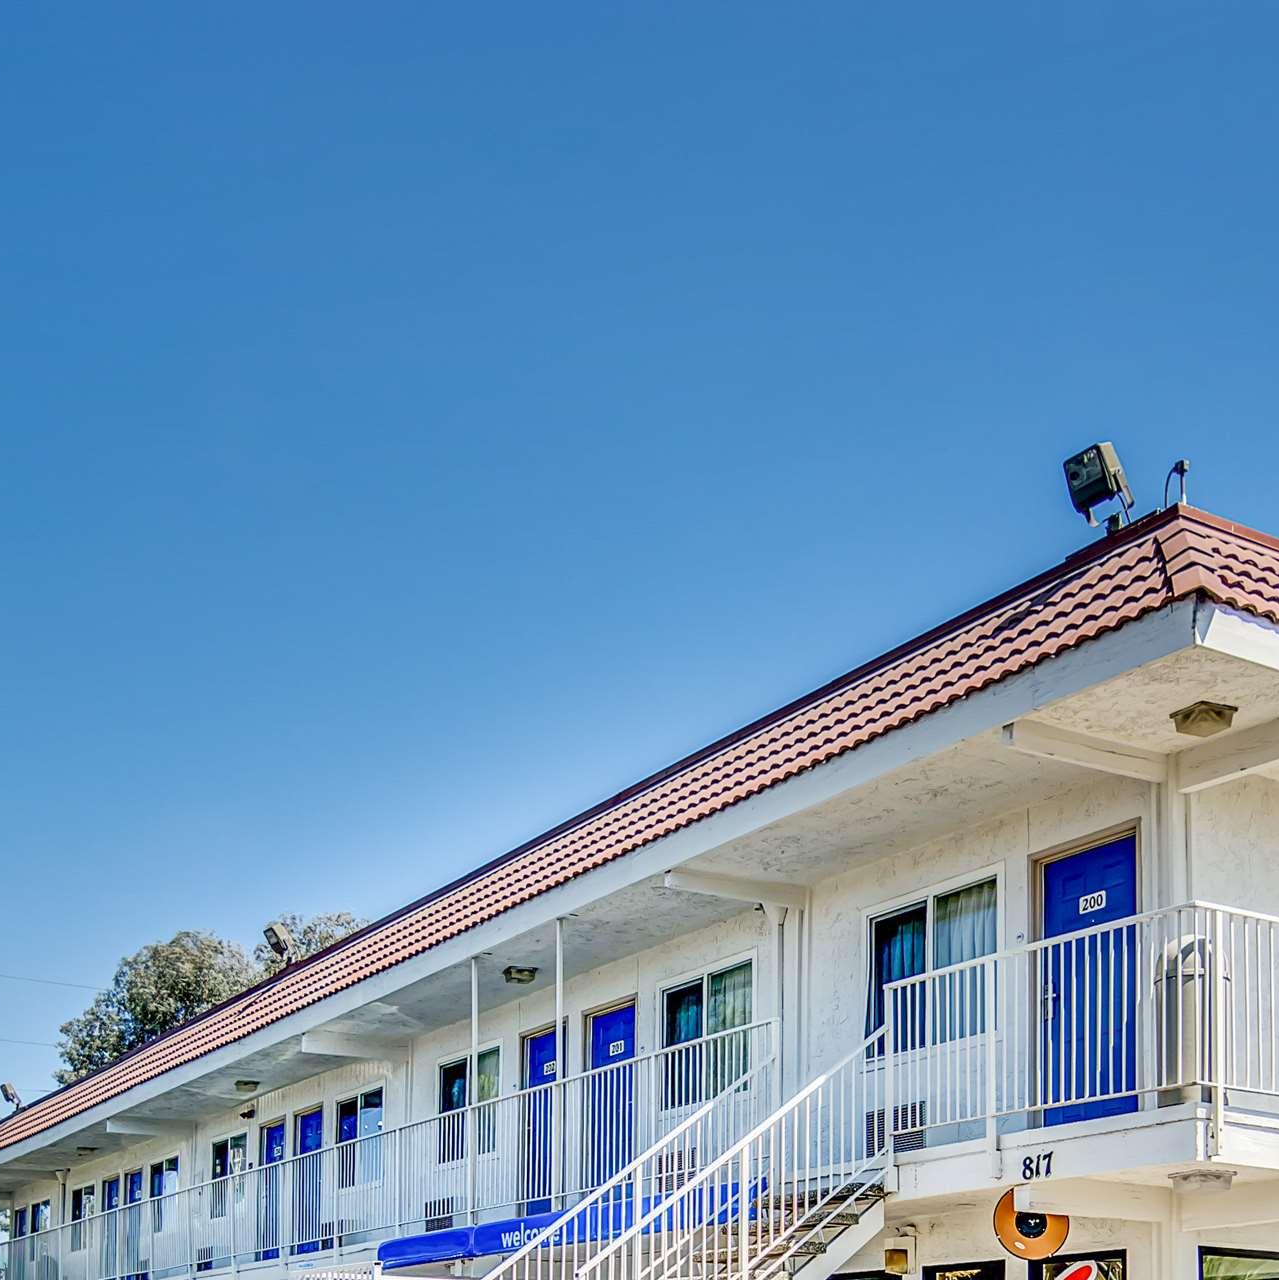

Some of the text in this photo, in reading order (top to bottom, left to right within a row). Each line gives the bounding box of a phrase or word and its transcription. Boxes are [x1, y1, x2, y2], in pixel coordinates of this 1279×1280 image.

[1082, 894, 1104, 911] 200
[611, 1042, 623, 1054] 201
[1022, 1151, 1054, 1180] 817
